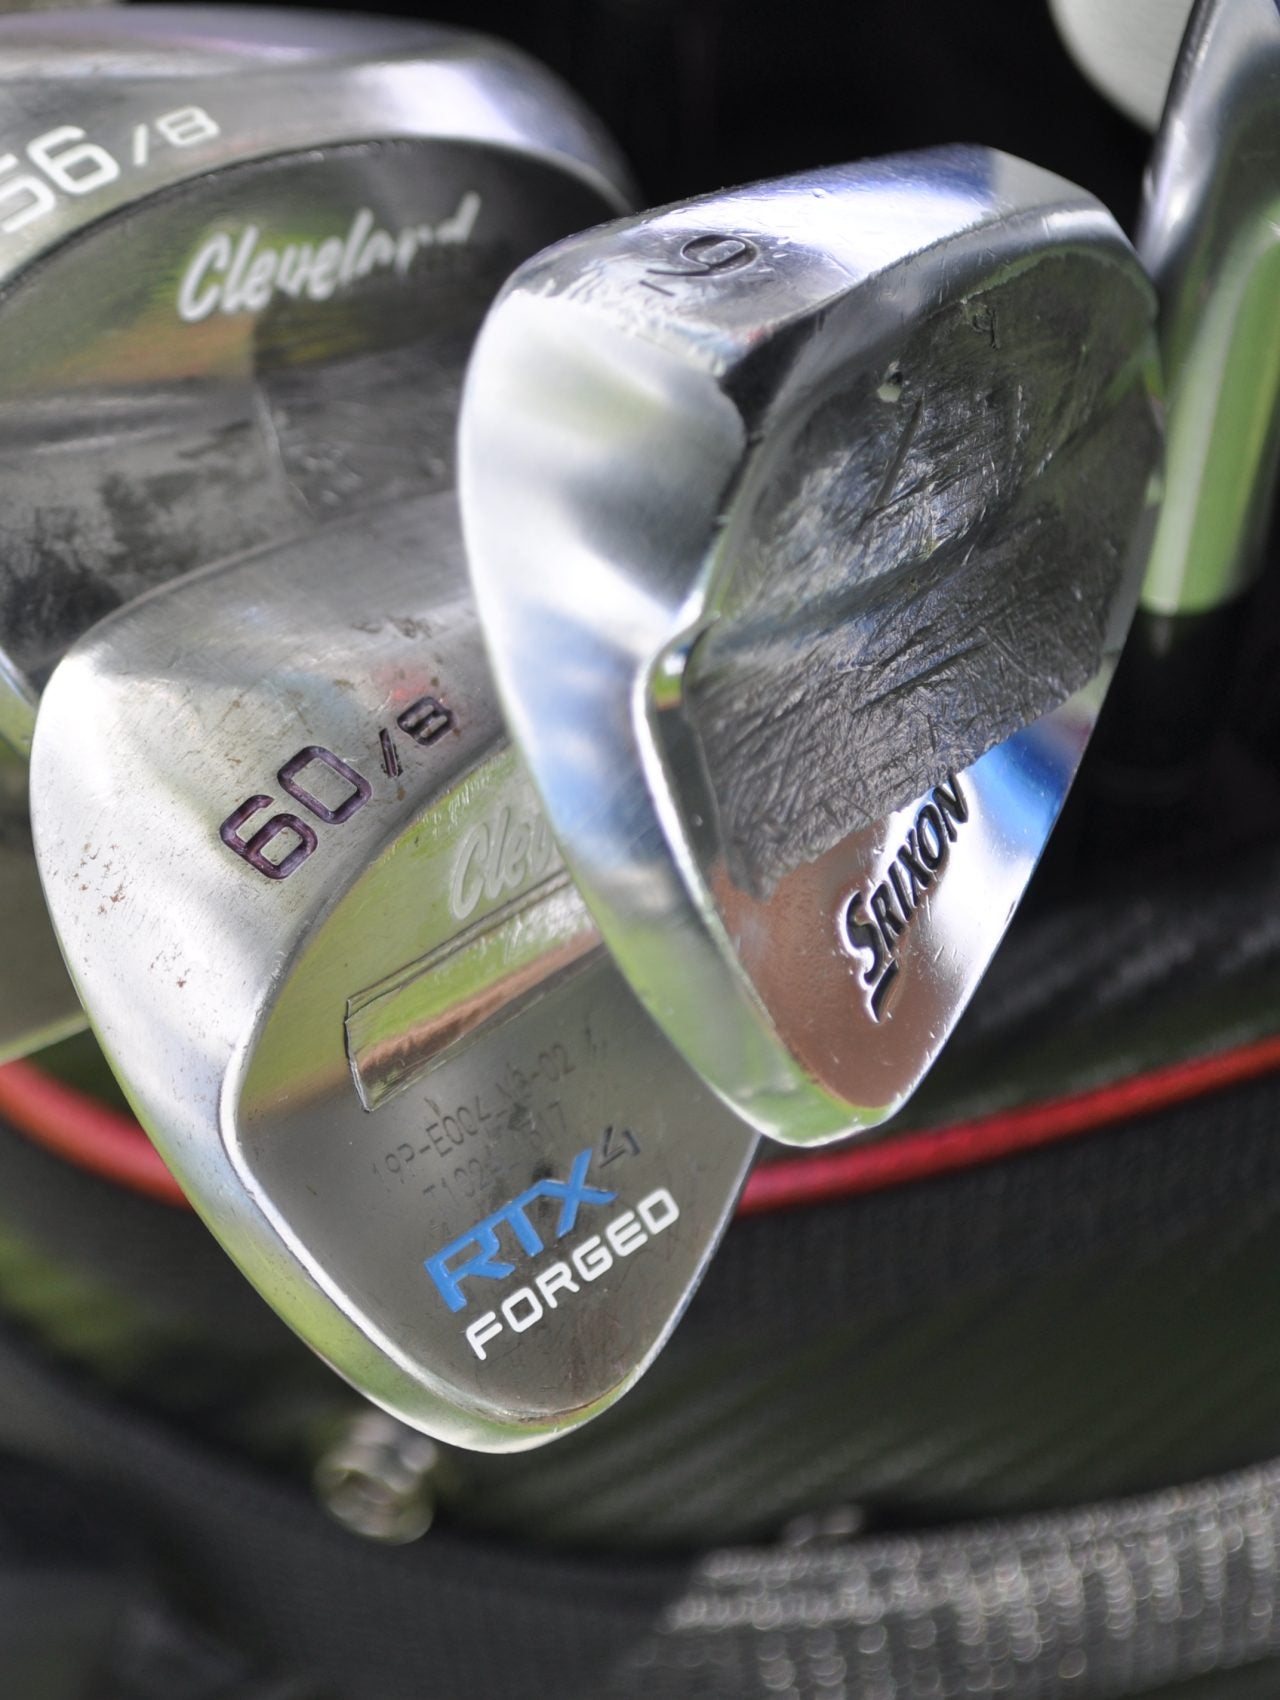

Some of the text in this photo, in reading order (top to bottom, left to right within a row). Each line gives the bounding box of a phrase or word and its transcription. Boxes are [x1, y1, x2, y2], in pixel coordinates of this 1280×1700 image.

[220, 695, 453, 880] 60/8
[838, 766, 970, 1023] SRIXON
[465, 1187, 680, 1361] FORGED
